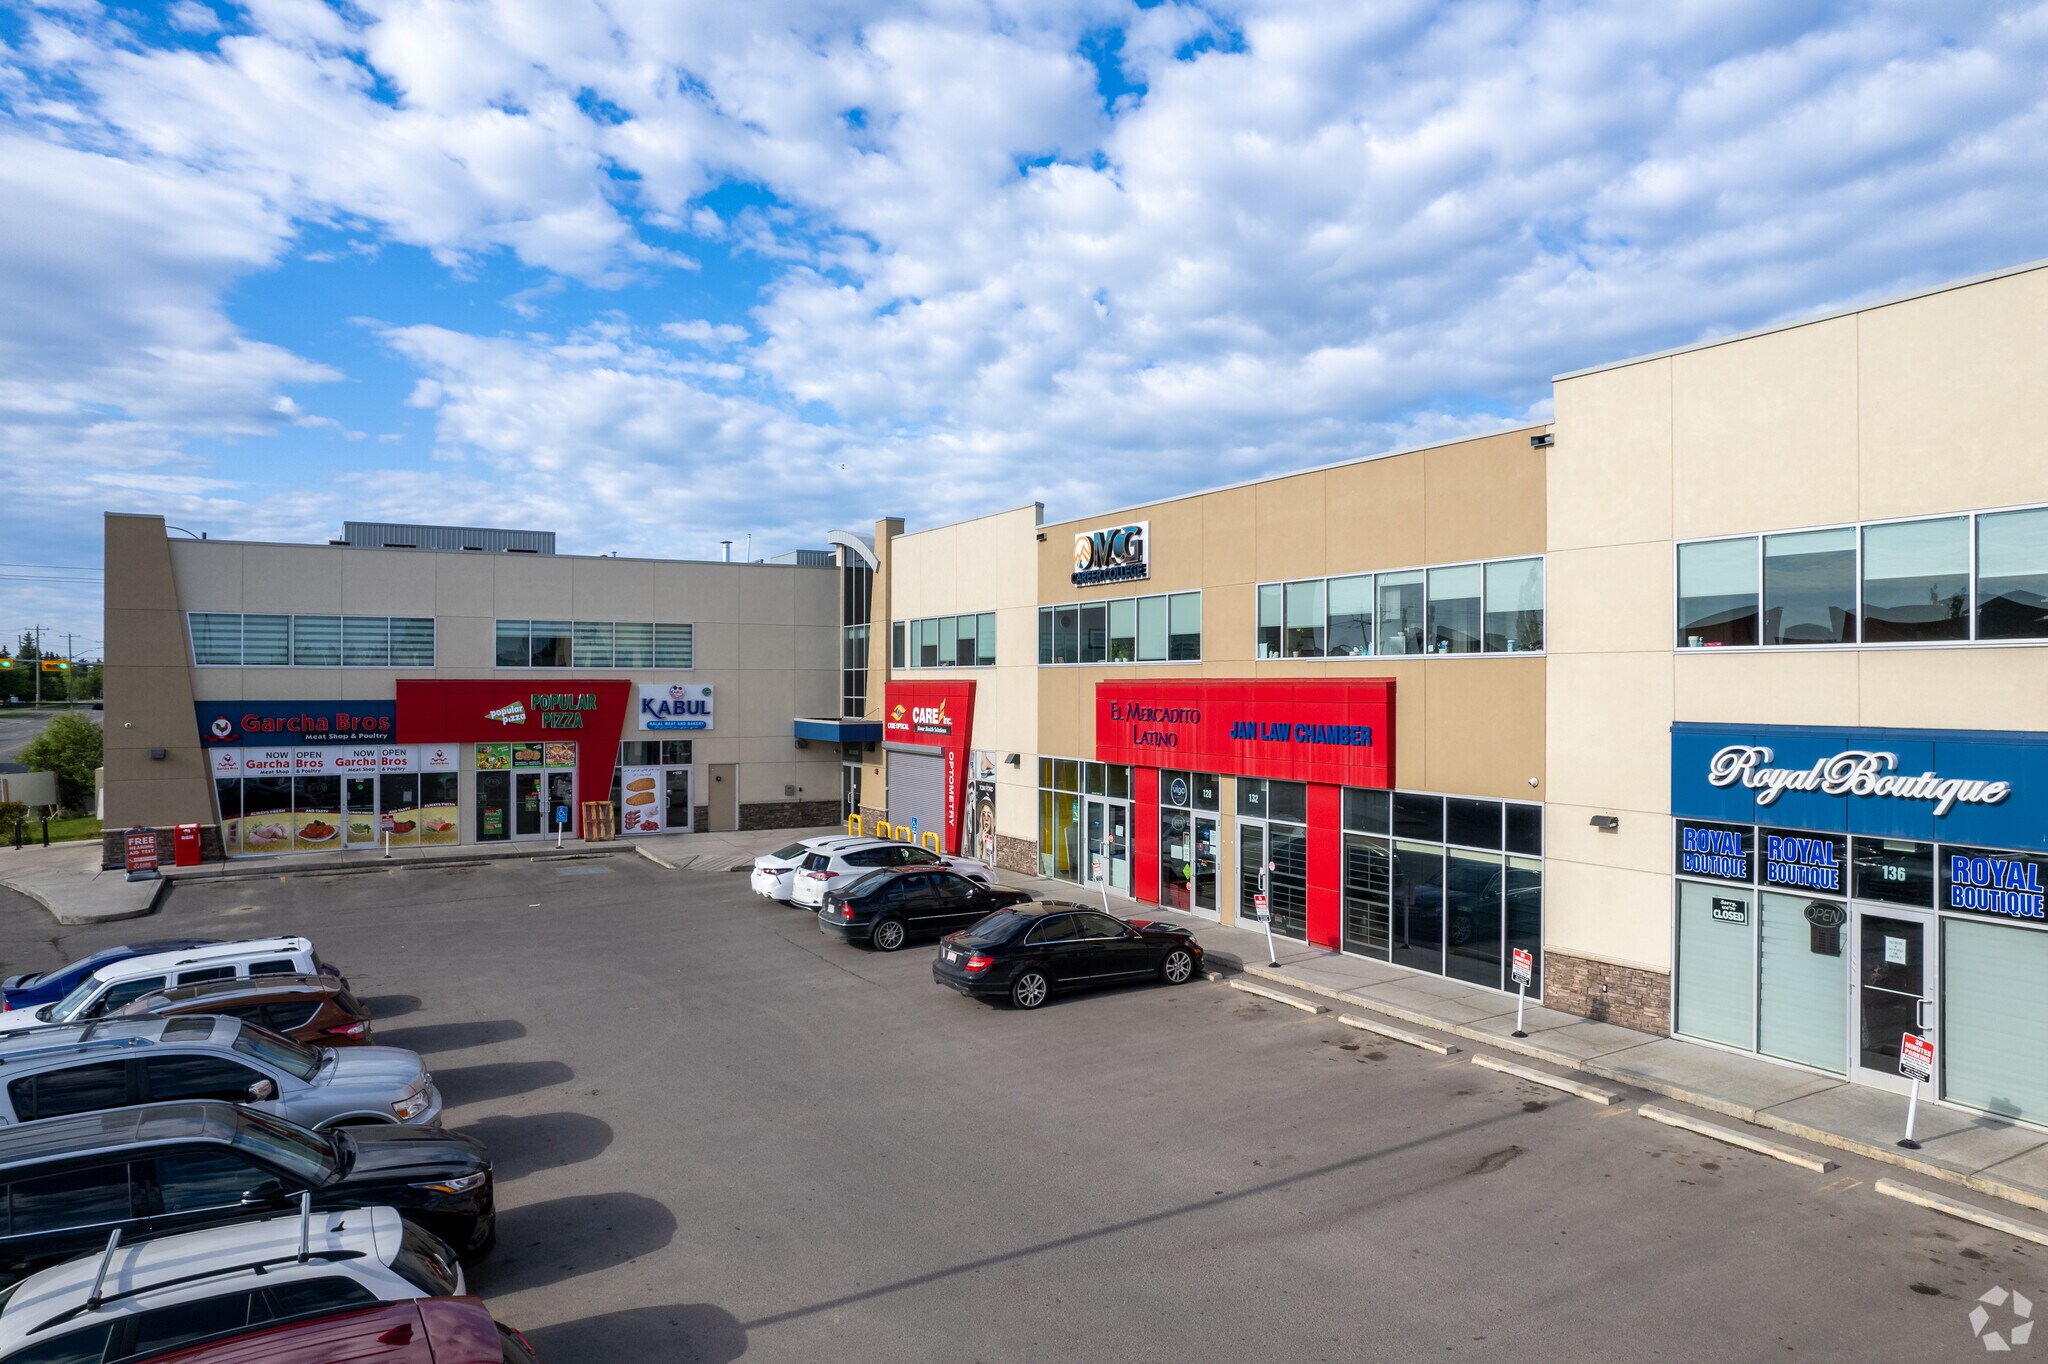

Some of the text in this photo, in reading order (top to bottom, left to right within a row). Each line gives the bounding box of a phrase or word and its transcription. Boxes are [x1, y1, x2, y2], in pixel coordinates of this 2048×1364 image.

[1071, 564, 1147, 584] CAREER COLLEGE
[531, 694, 597, 711] POPULAR
[641, 698, 711, 719] KABUL
[490, 705, 524, 719] popular
[502, 713, 526, 725] pizza
[542, 712, 583, 729] PIZZA
[912, 707, 953, 725] CARE Inc.
[241, 713, 390, 733] Garcha Bros
[329, 733, 349, 741] Shop
[358, 732, 388, 741] Poultry
[1133, 724, 1178, 748] LATINO
[1230, 721, 1373, 747] JAN LAW CHAMBER
[246, 759, 324, 769] Garcha Bros
[335, 757, 408, 767] Garcha Bros
[1708, 745, 2012, 816] Royal Boutique
[1172, 786, 1186, 796] vigo
[1203, 789, 1212, 799] 128
[1248, 794, 1258, 803] 132
[128, 836, 154, 846] FREE
[1683, 827, 1746, 857] ROYAL
[1767, 835, 1839, 868] ROYAL
[1683, 853, 1747, 879] BOUTIQUE
[1882, 865, 1906, 882] 136
[1951, 855, 2045, 893] ROYAL
[1767, 862, 1839, 890] BOUTIQUE
[1951, 885, 2045, 919] BOUTIQUE
[1713, 908, 1744, 922] CLOSED
[1806, 906, 1840, 922] OPEN
[1904, 1048, 1931, 1062] PARKING
[1905, 1042, 1932, 1057] MINUTES
